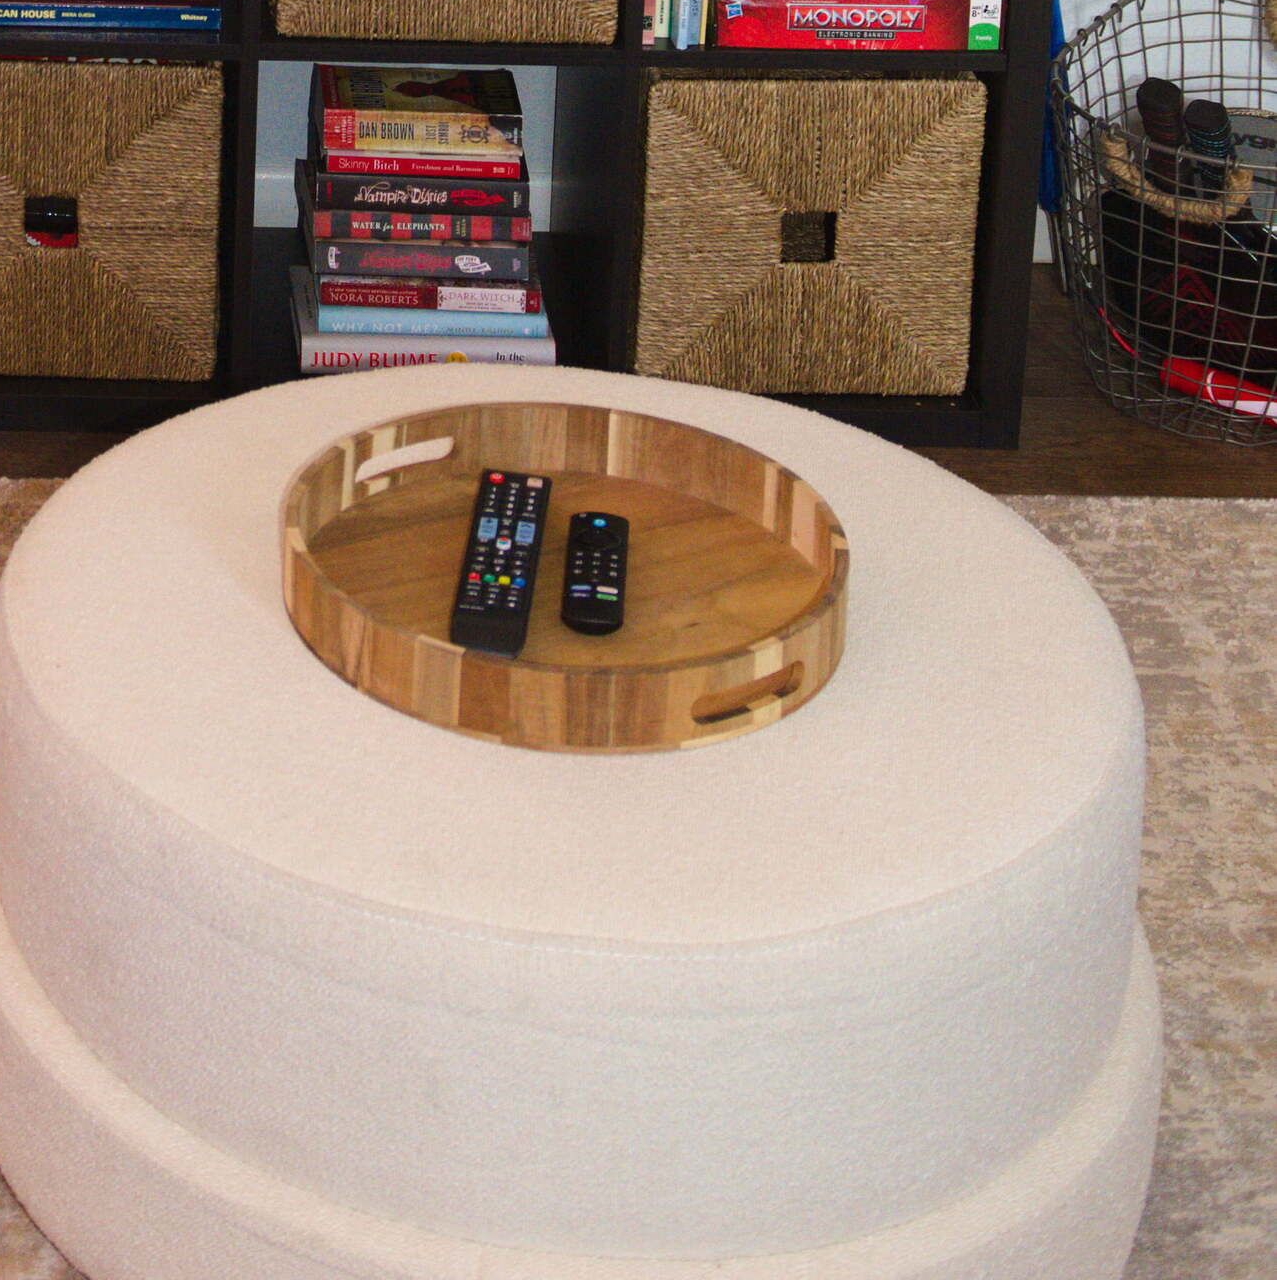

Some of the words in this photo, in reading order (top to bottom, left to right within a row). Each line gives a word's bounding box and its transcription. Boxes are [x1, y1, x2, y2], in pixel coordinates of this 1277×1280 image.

[20, 9, 56, 19] HOUSE
[793, 8, 920, 28] MONOPOLY
[818, 30, 861, 38] ELECTRONIC
[863, 31, 894, 39] BANKING
[359, 121, 378, 139] DAN
[381, 122, 415, 141] BROWN
[338, 158, 370, 172] Skinny
[373, 159, 399, 171] Bitch
[442, 164, 455, 172] and
[352, 221, 382, 230] WATER
[382, 221, 394, 232] for
[396, 221, 445, 231] ELEPHANTS
[330, 292, 363, 303] NORA
[368, 294, 419, 305] ROBERTS
[448, 291, 477, 302] DARK
[480, 292, 516, 303] WITCH
[331, 321, 365, 333] WHY
[372, 321, 403, 333] NOT
[410, 324, 439, 335] ME?
[310, 351, 363, 368] JUDY
[369, 352, 437, 368] BLUME
[496, 351, 507, 361] In
[509, 351, 526, 362] the
